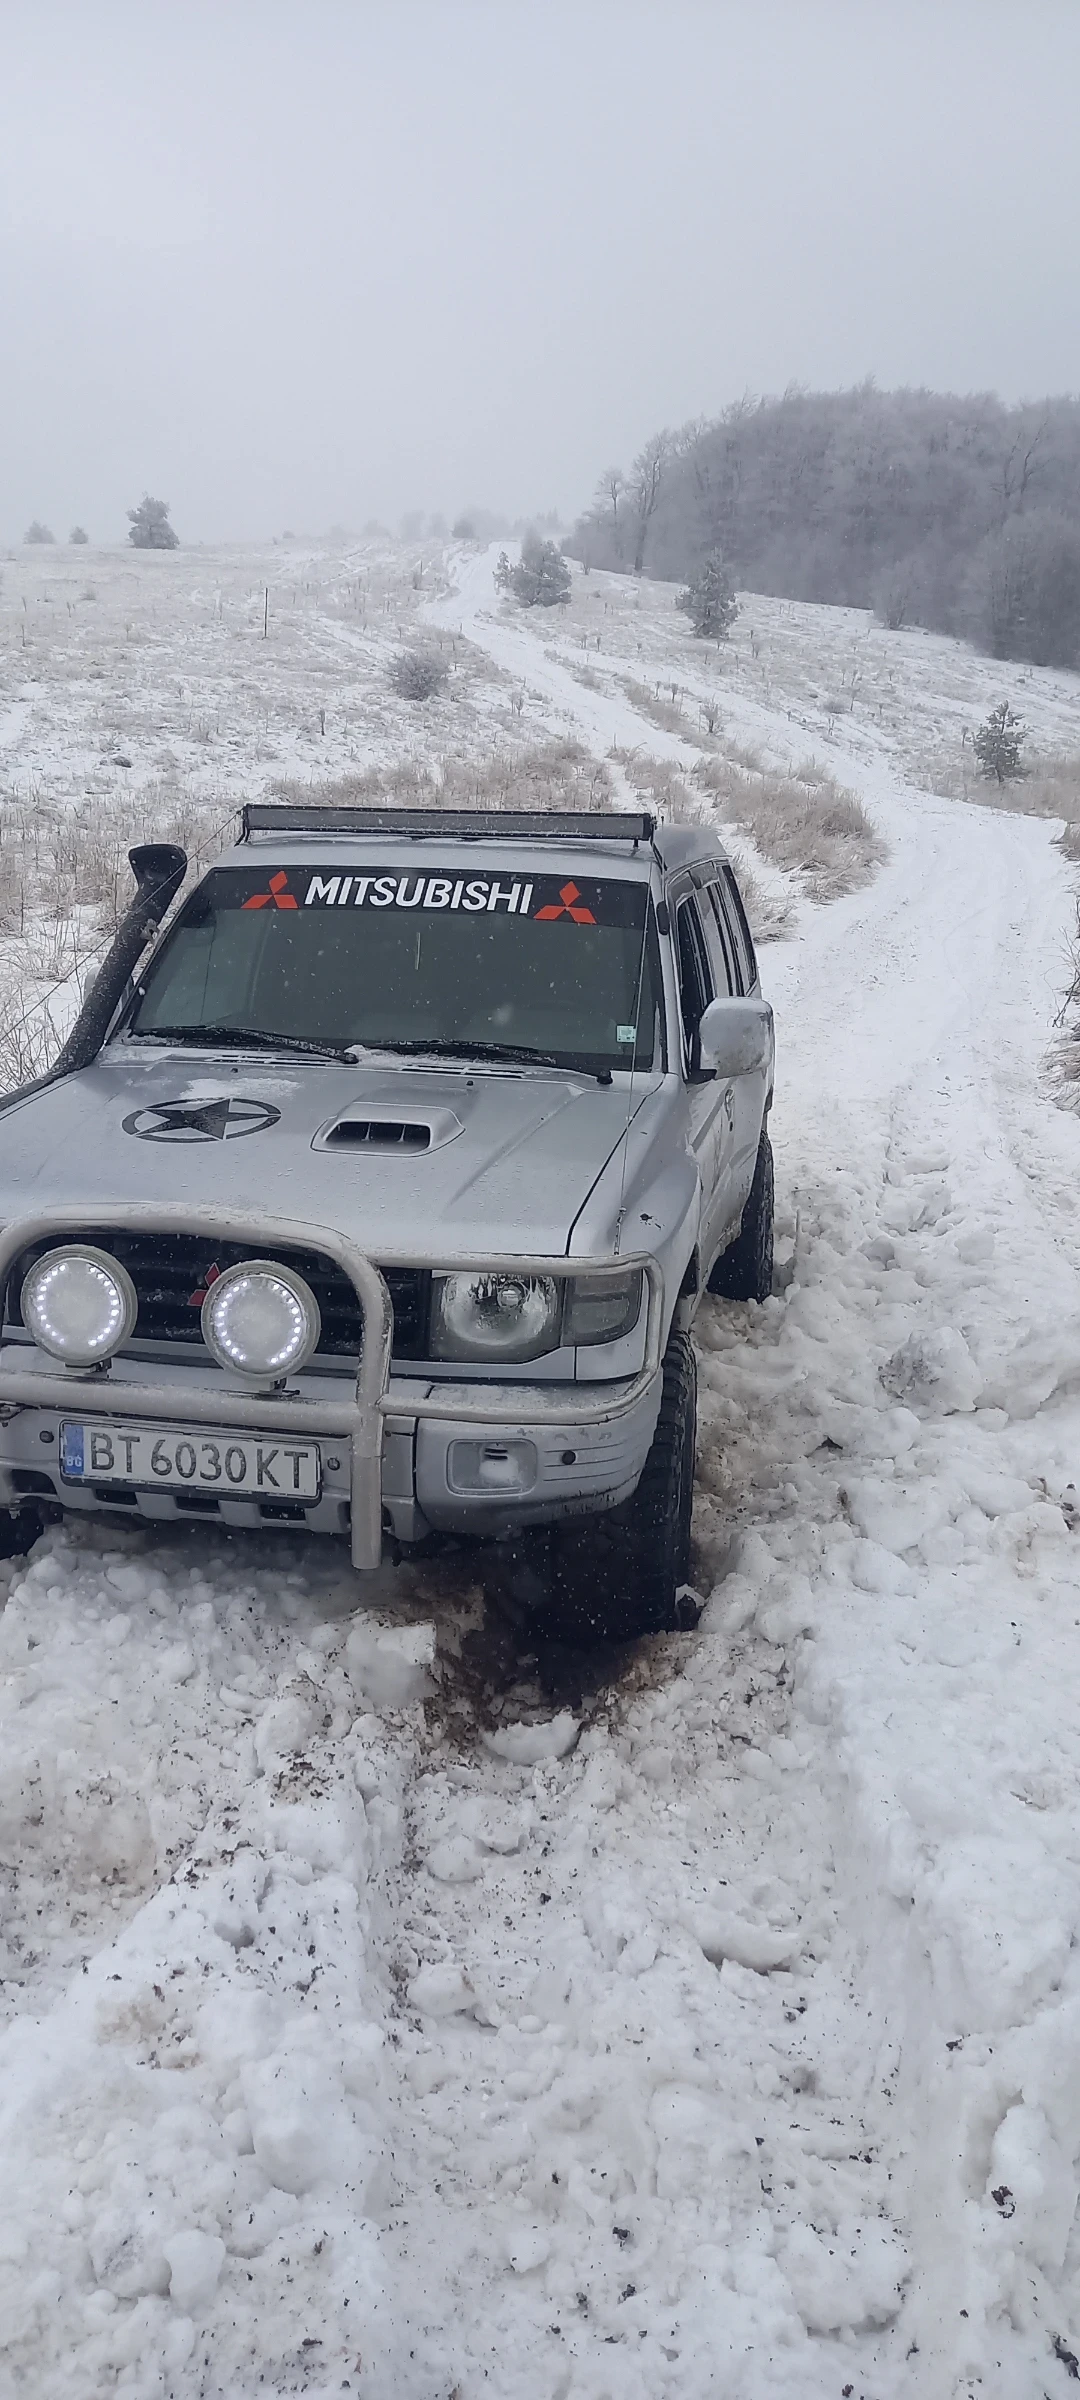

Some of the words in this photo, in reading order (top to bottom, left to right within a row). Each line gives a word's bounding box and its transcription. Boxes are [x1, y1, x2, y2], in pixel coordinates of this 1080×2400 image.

[304, 876, 533, 914] MITSUBISHI
[66, 1455, 82, 1467] BG
[90, 1432, 140, 1473] BT
[151, 1439, 246, 1483] 6030
[256, 1448, 309, 1489] KT
